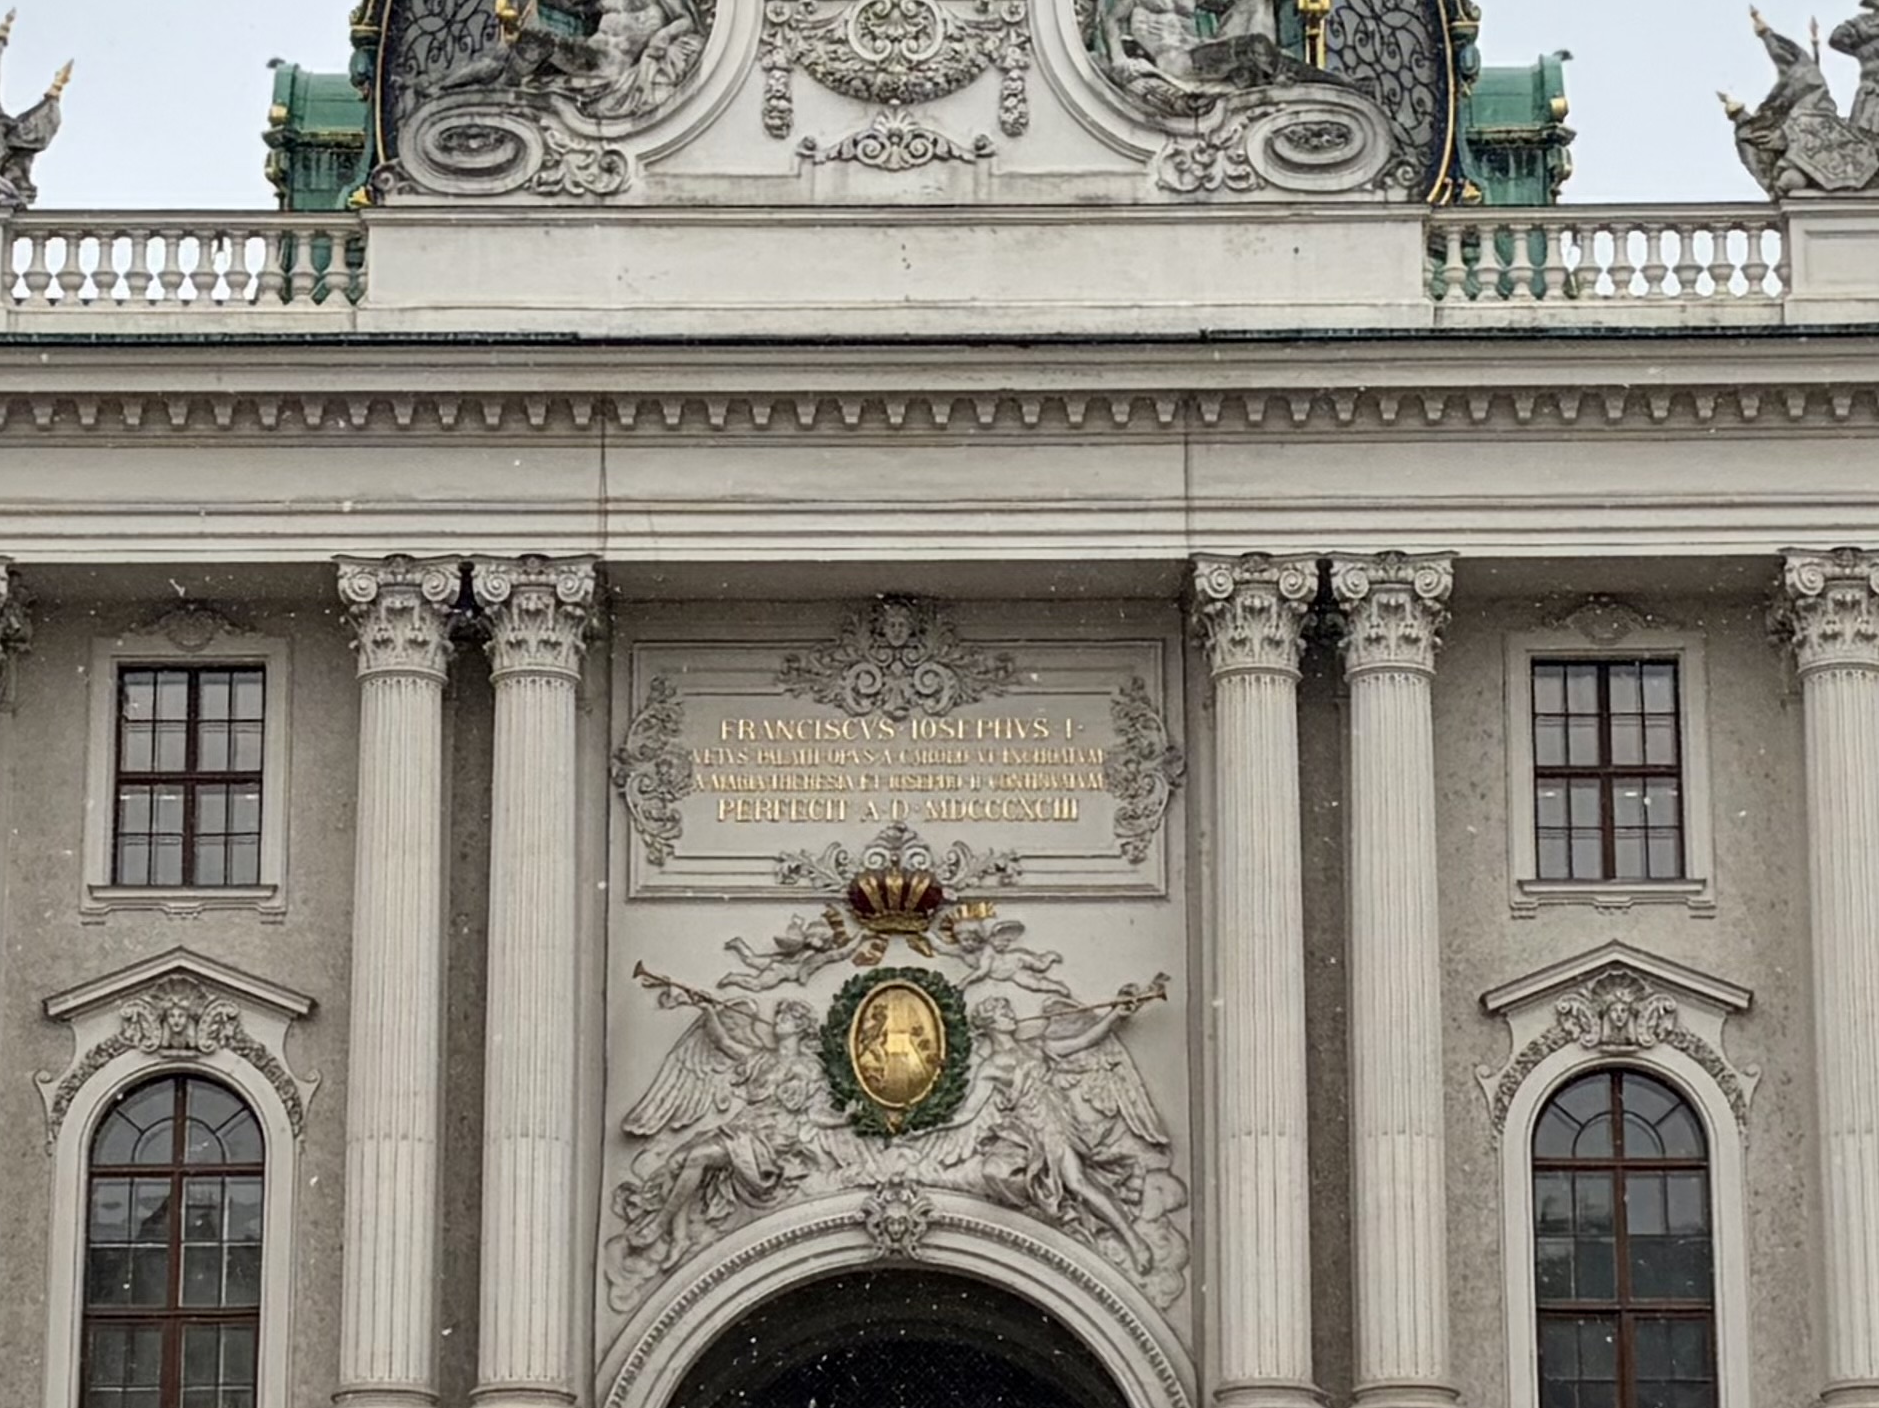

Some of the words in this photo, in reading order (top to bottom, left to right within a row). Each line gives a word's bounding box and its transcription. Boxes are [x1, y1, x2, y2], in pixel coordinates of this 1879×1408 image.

[721, 718, 896, 741] FRANCISCVS
[910, 717, 1051, 740] IOSEPHVS
[718, 797, 848, 823] PERFECIT
